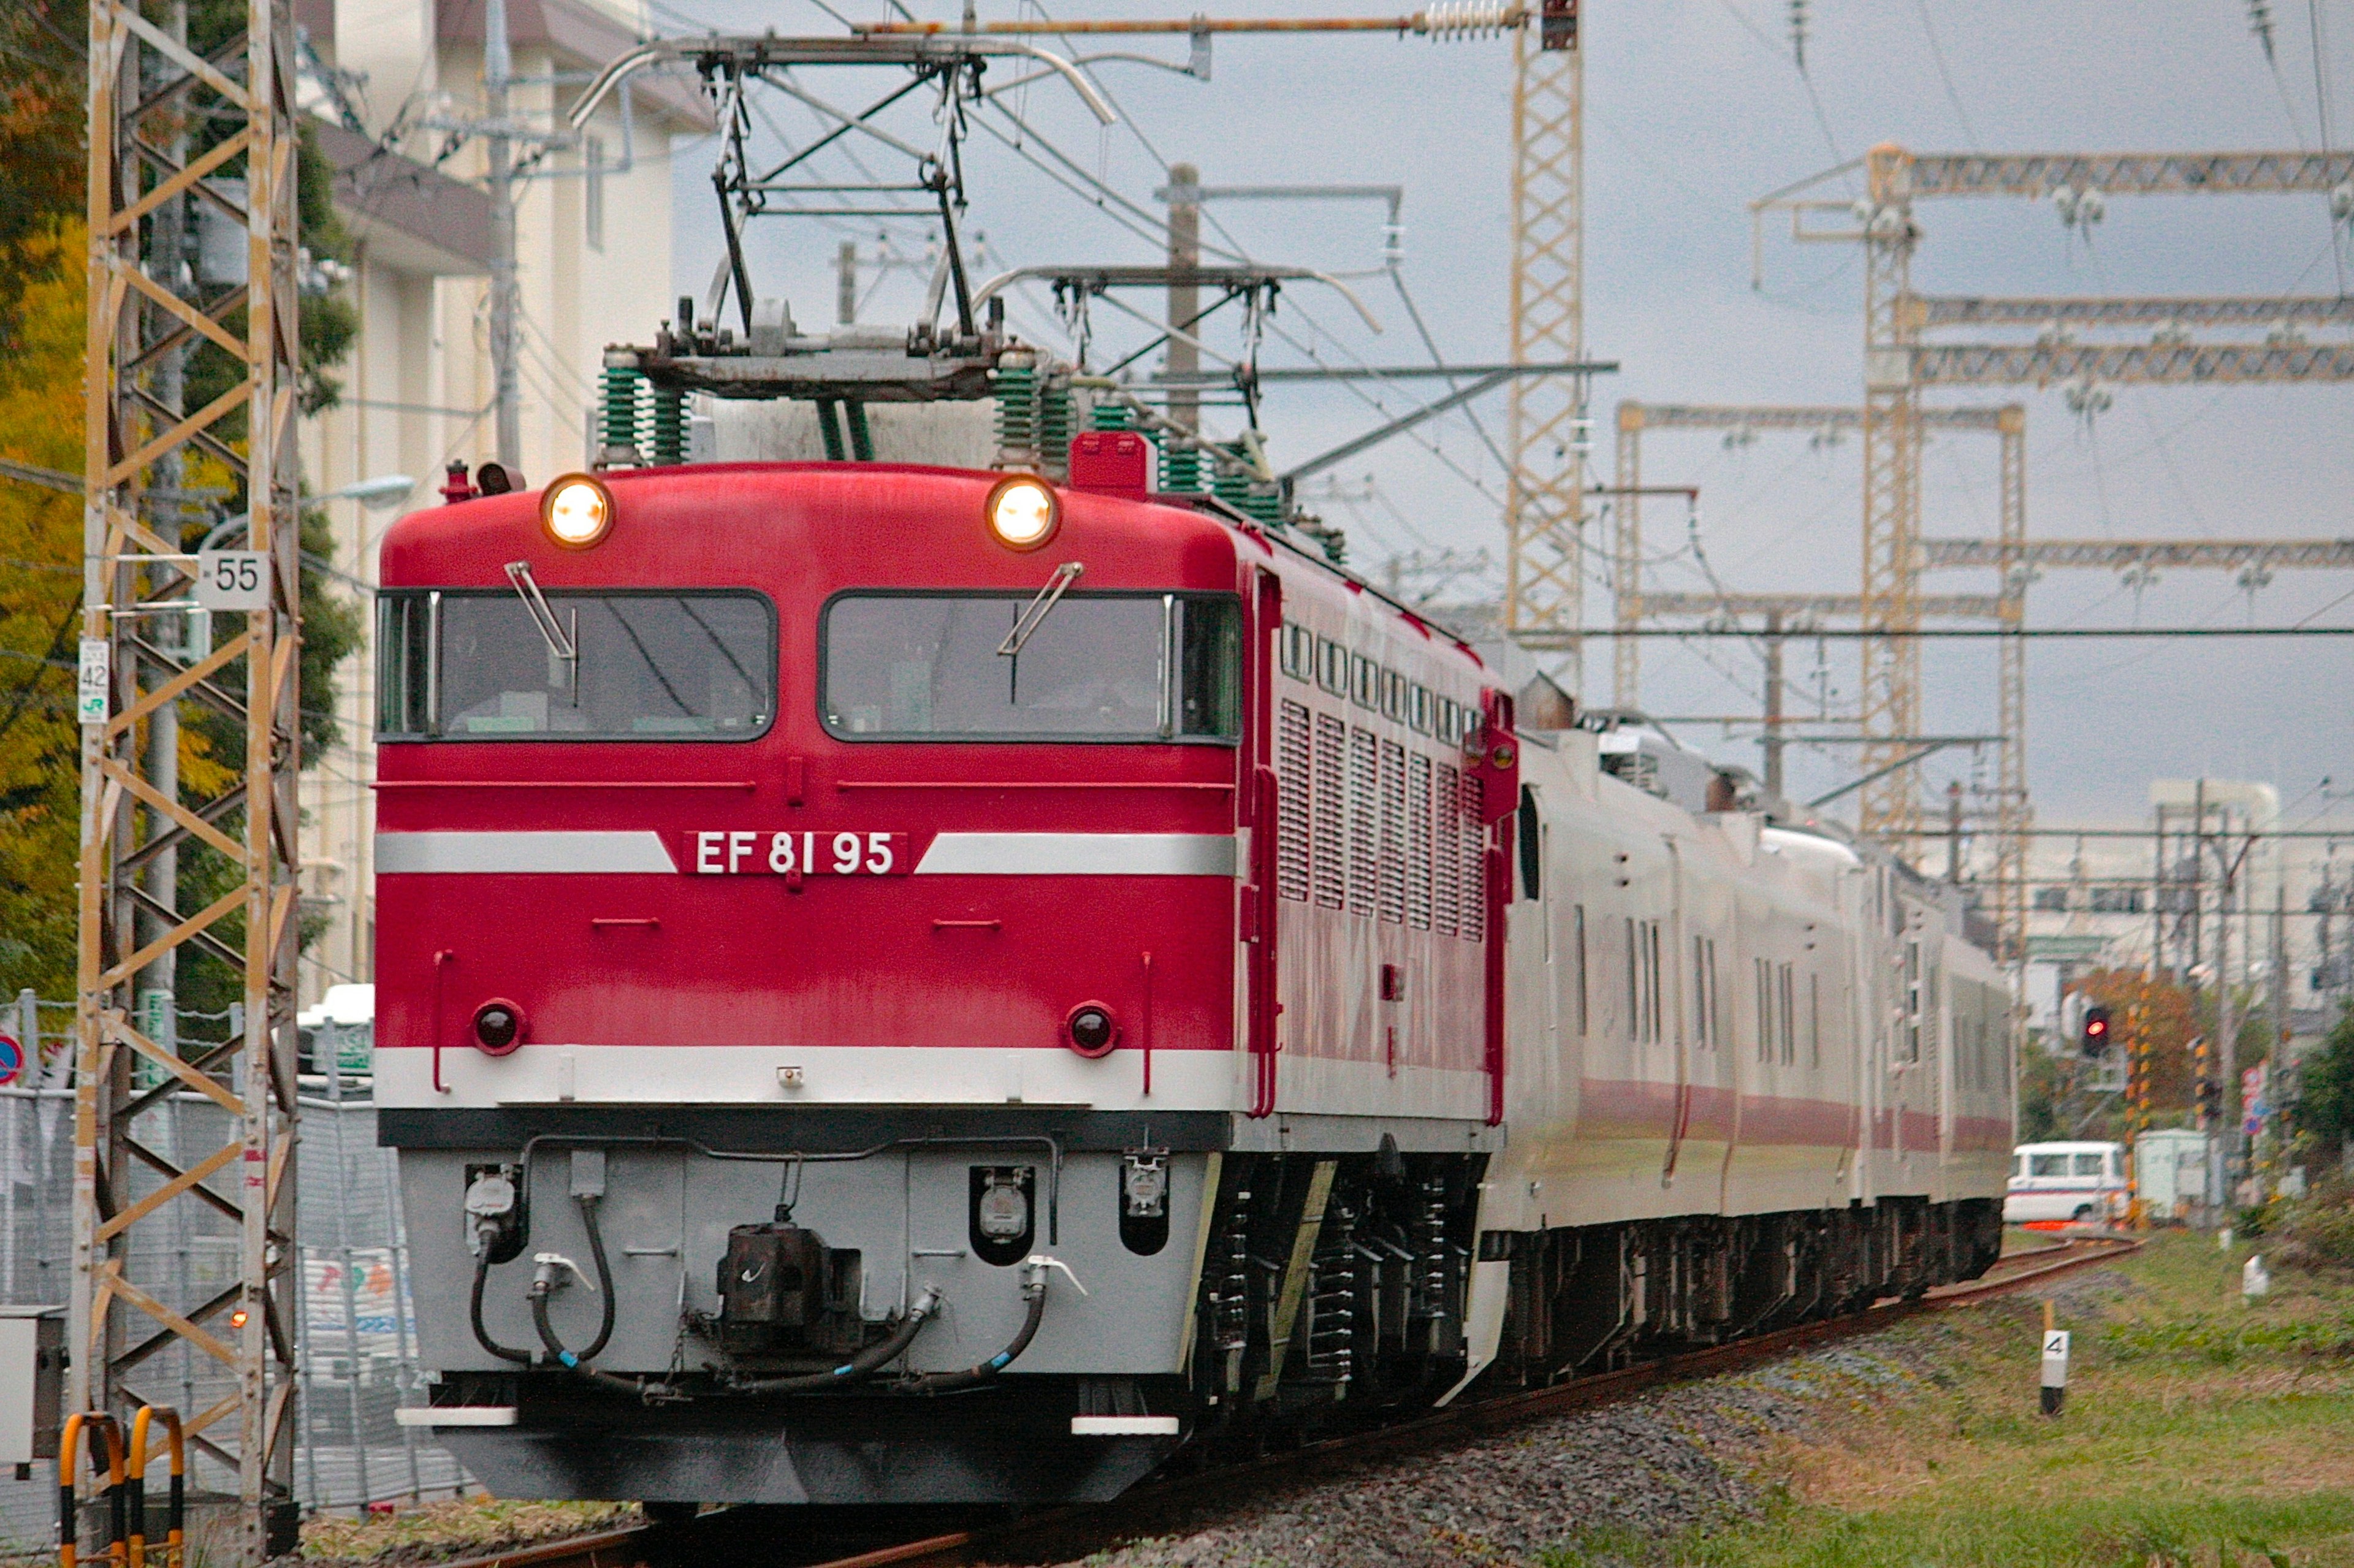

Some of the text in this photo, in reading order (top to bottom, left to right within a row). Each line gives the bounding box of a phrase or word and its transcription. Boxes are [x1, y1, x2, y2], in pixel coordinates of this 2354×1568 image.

[216, 558, 257, 592] 55
[83, 664, 105, 687] 42
[83, 698, 104, 711] JR
[697, 831, 893, 875] EF 81 95
[2045, 1336, 2062, 1355] 4
